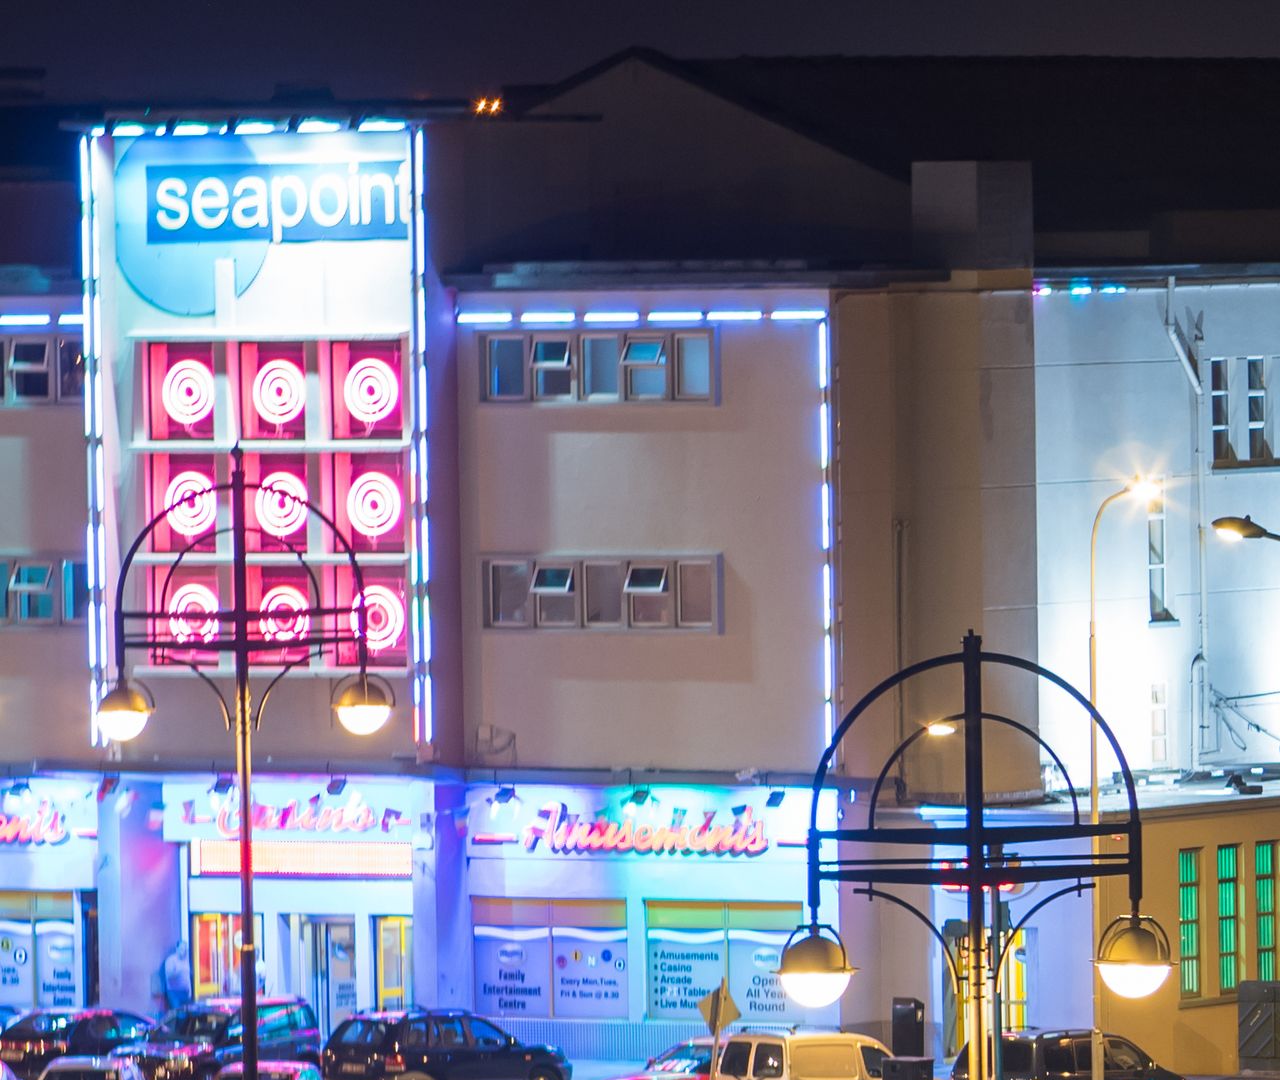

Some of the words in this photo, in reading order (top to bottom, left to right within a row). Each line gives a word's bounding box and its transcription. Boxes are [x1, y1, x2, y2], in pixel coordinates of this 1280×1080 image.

[155, 160, 412, 245] seapoint
[523, 802, 770, 857] Amusements
[659, 951, 719, 962] Amusements
[659, 963, 692, 973] Casino
[498, 969, 526, 983] Family
[659, 976, 693, 985] Arcade
[483, 983, 542, 997] Entertainment
[746, 989, 764, 1001] All
[659, 1000, 678, 1010] Live
[749, 1001, 786, 1013] Round
